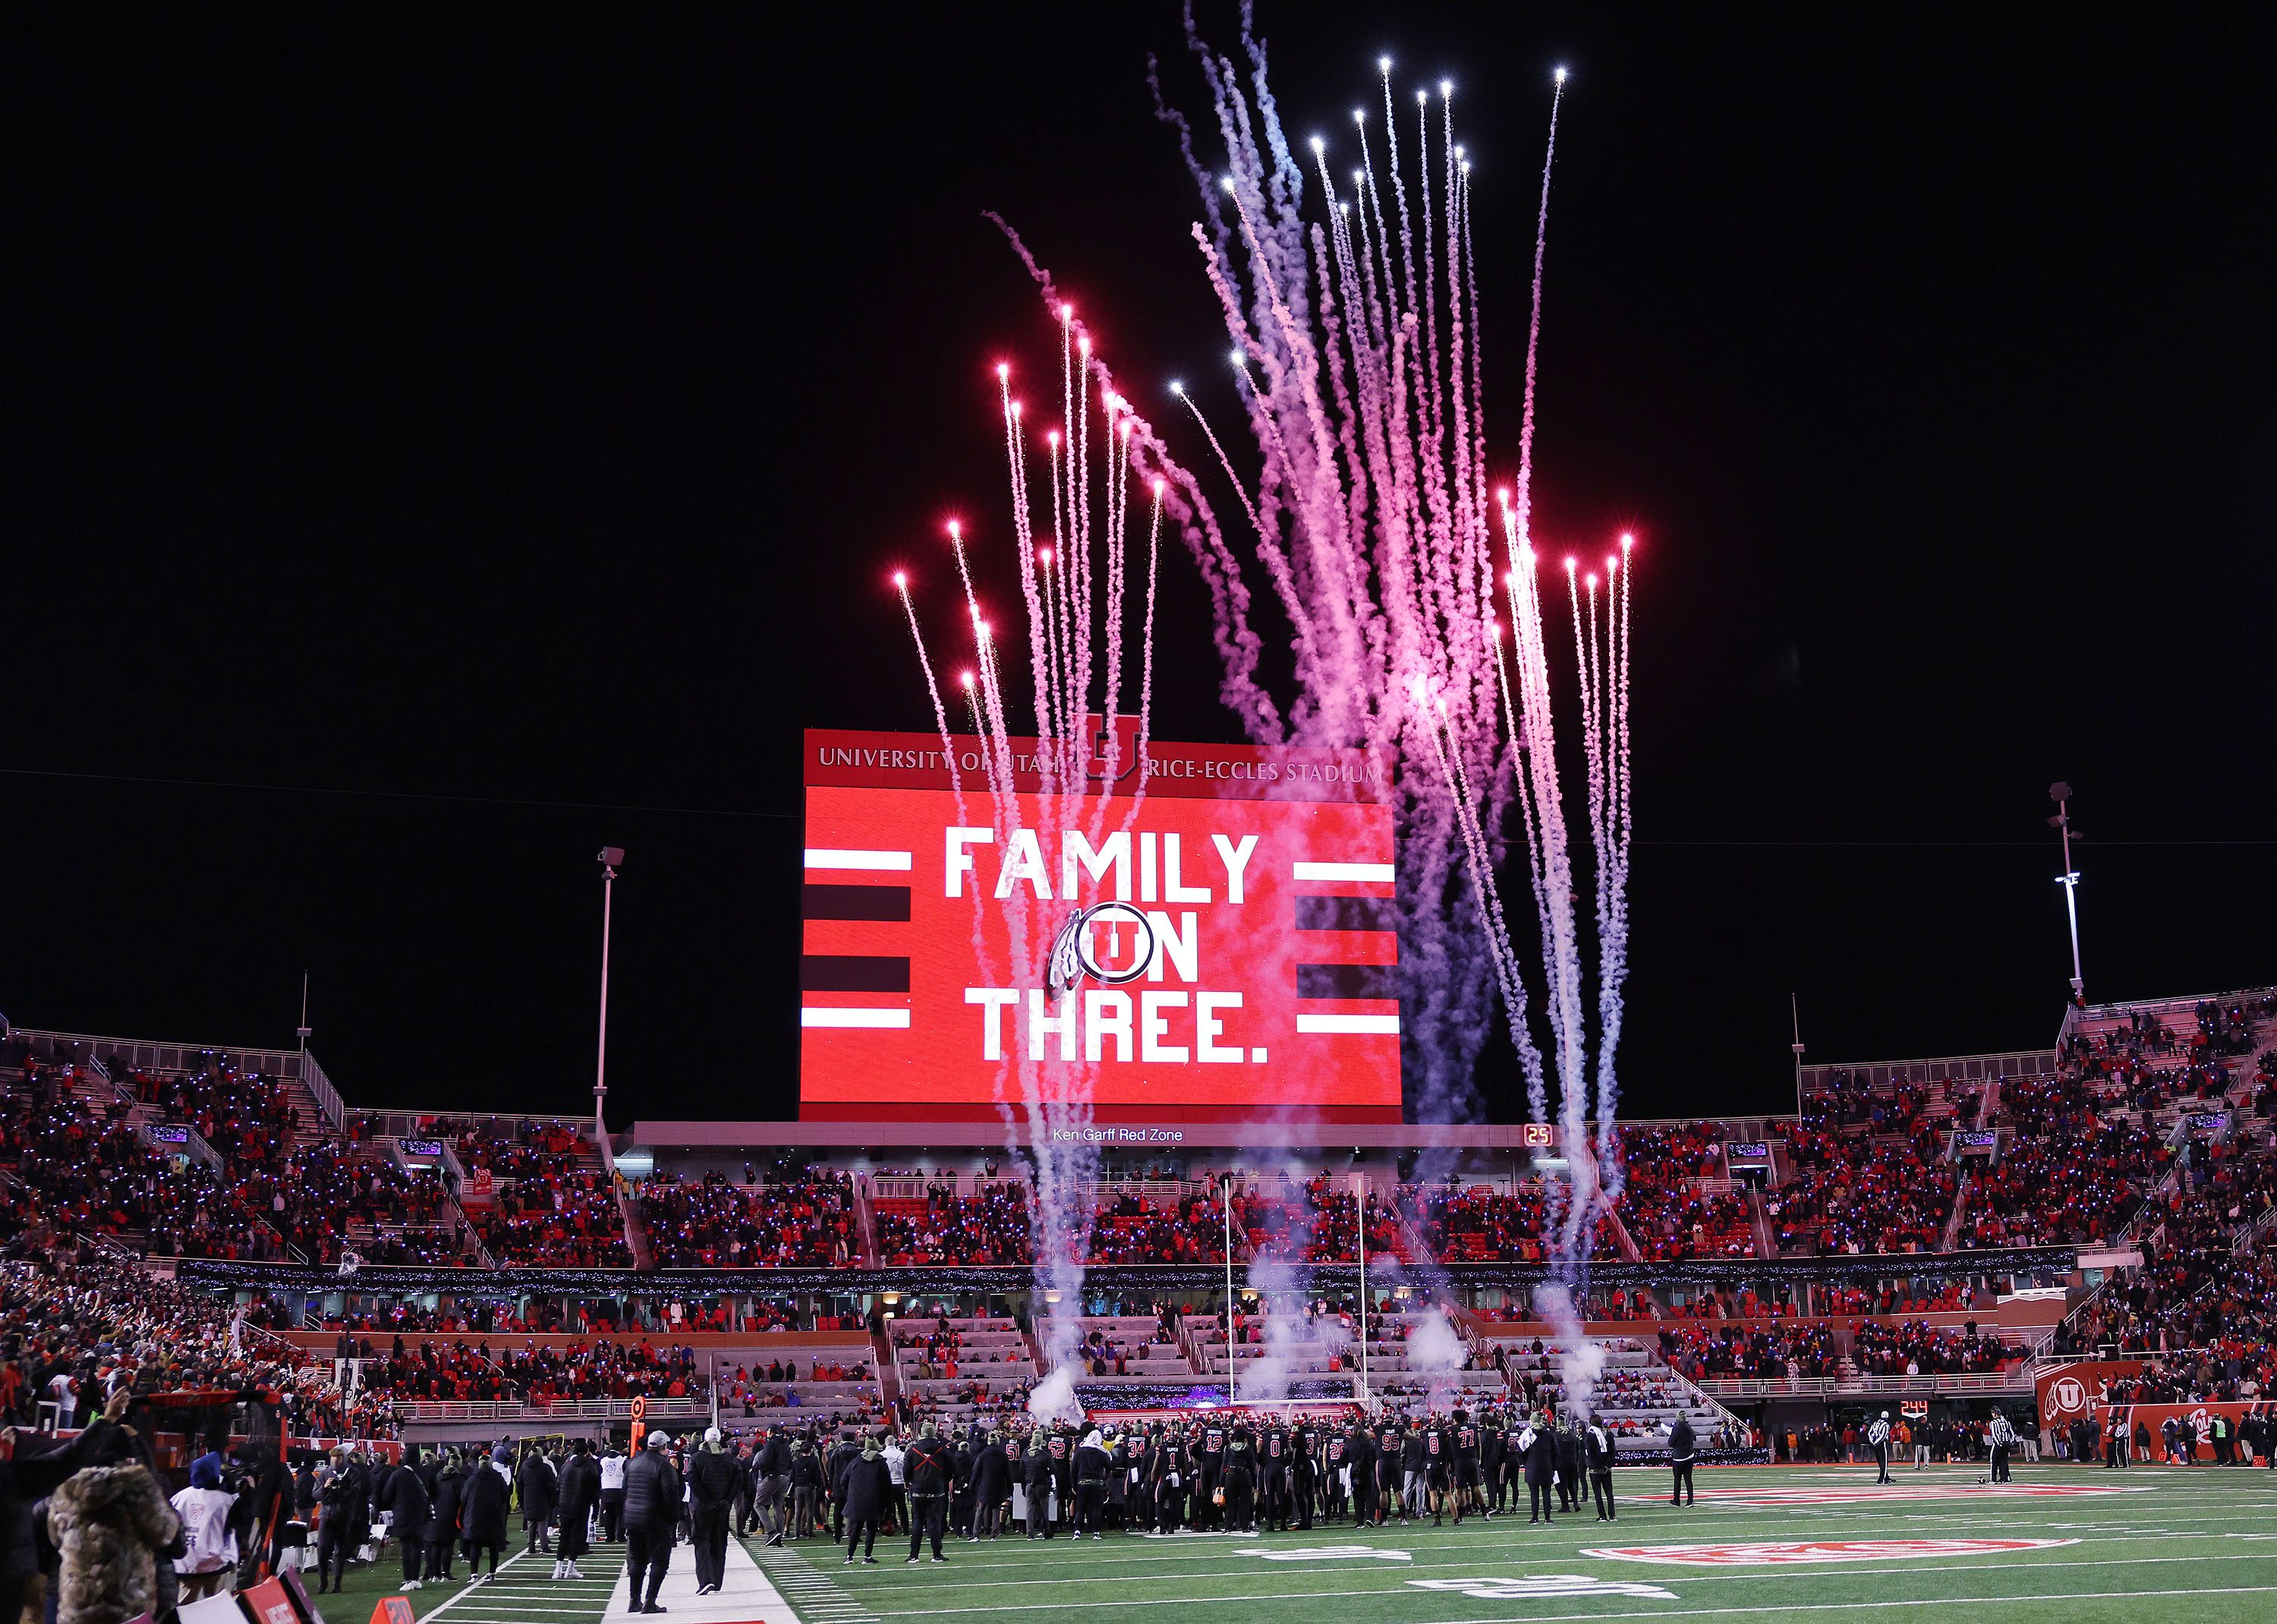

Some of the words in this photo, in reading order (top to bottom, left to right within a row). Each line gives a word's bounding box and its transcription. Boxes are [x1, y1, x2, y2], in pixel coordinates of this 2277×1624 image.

[820, 747, 951, 770] UNIVERSITY
[1148, 758, 1278, 780] RICE-ECCLES
[1286, 763, 1383, 784] STADIUM
[946, 826, 1259, 904] FAMILY
[965, 987, 1268, 1063] THREE.
[1053, 1128, 1079, 1141] Ken
[1082, 1128, 1116, 1141] Garff
[1120, 1128, 1146, 1141] Red
[1149, 1128, 1183, 1141] Zone
[1529, 1127, 1548, 1143] 25
[1901, 1401, 1928, 1414] 244
[1207, 1435, 1223, 1452] 12
[1306, 1438, 1314, 1455] 3
[1382, 1434, 1399, 1451] 95
[1429, 1437, 1439, 1454] 8
[1458, 1430, 1475, 1448] 77
[1006, 1444, 1020, 1461] 51
[1048, 1442, 1066, 1459] 52
[1128, 1442, 1145, 1458] 34
[1271, 1440, 1280, 1457] 0
[1170, 1452, 1176, 1469] 1
[387, 1601, 414, 1624] 20
